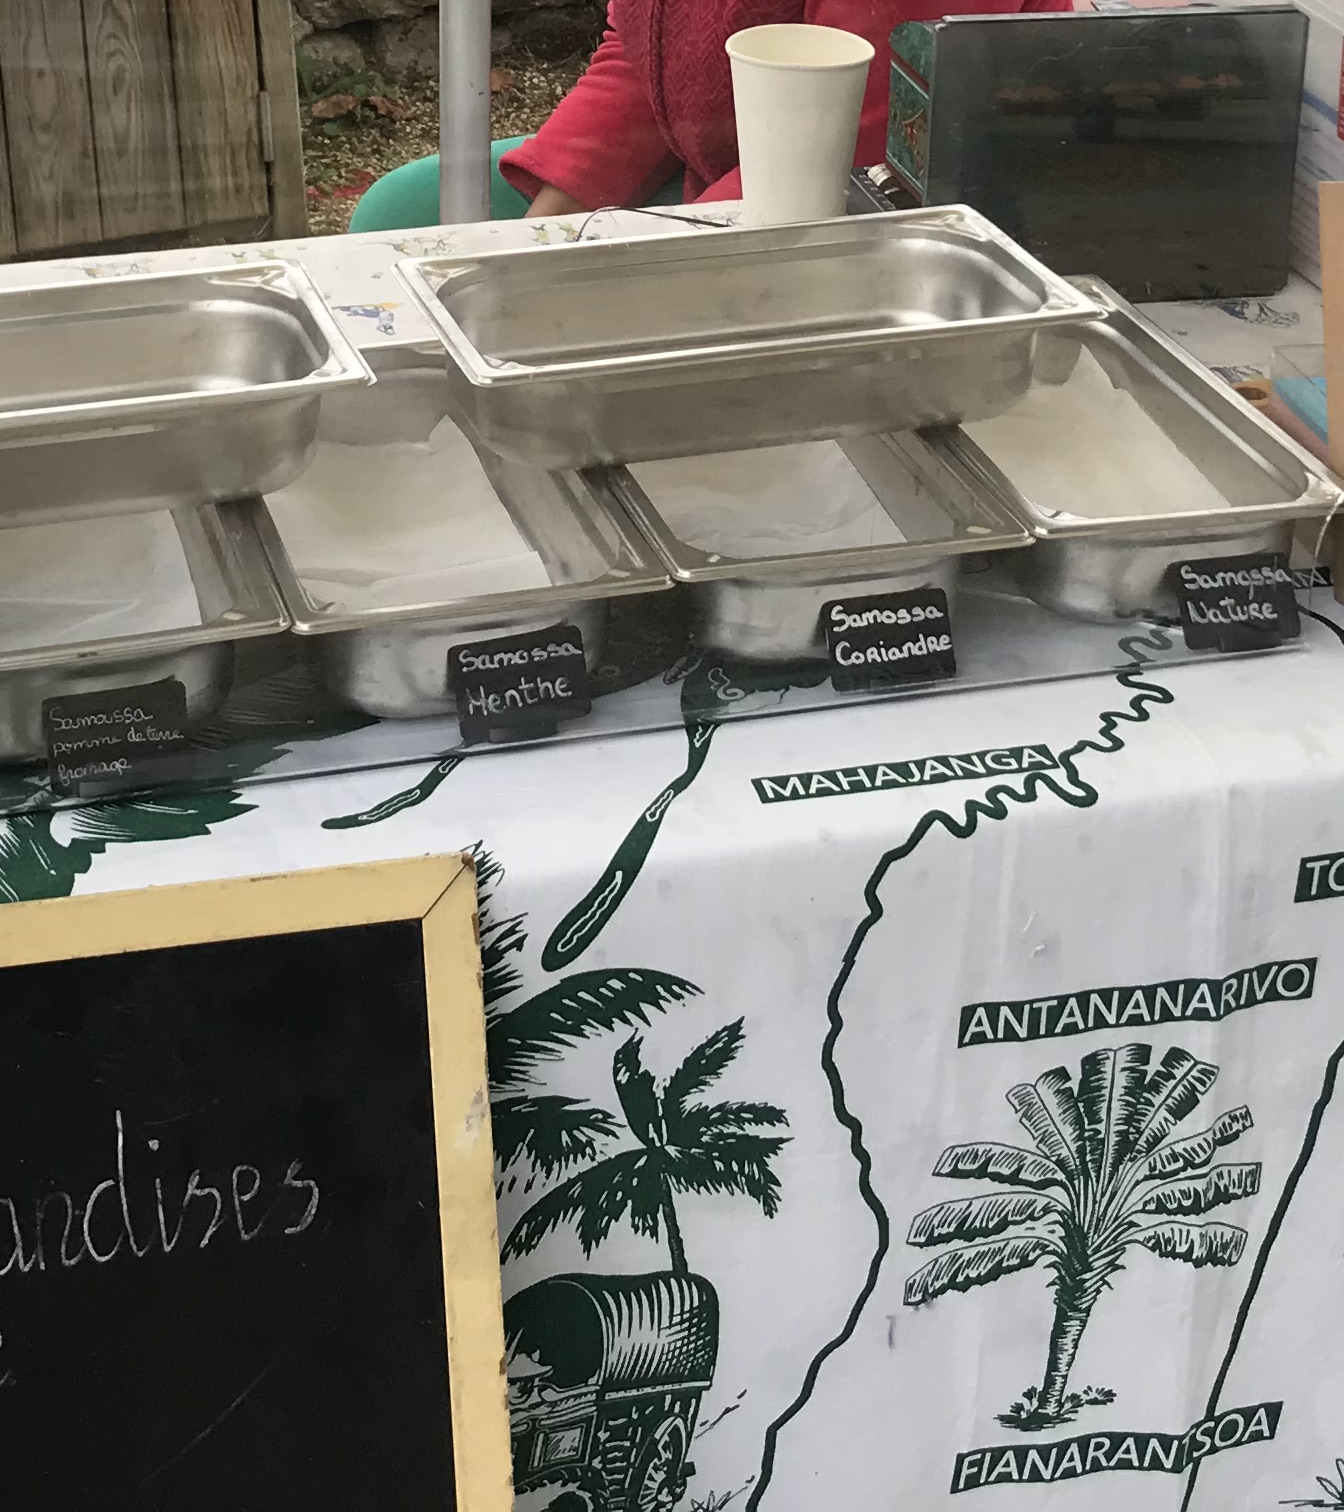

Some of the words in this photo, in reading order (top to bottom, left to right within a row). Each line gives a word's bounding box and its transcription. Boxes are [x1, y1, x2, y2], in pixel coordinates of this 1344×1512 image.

[1181, 564, 1292, 589] Samossa
[830, 602, 944, 633] Samossa
[459, 640, 582, 674] Samossa
[53, 735, 122, 757] pomme
[760, 747, 1054, 800] MAHAJANGA
[961, 962, 1311, 1041] ANTANANARIVO
